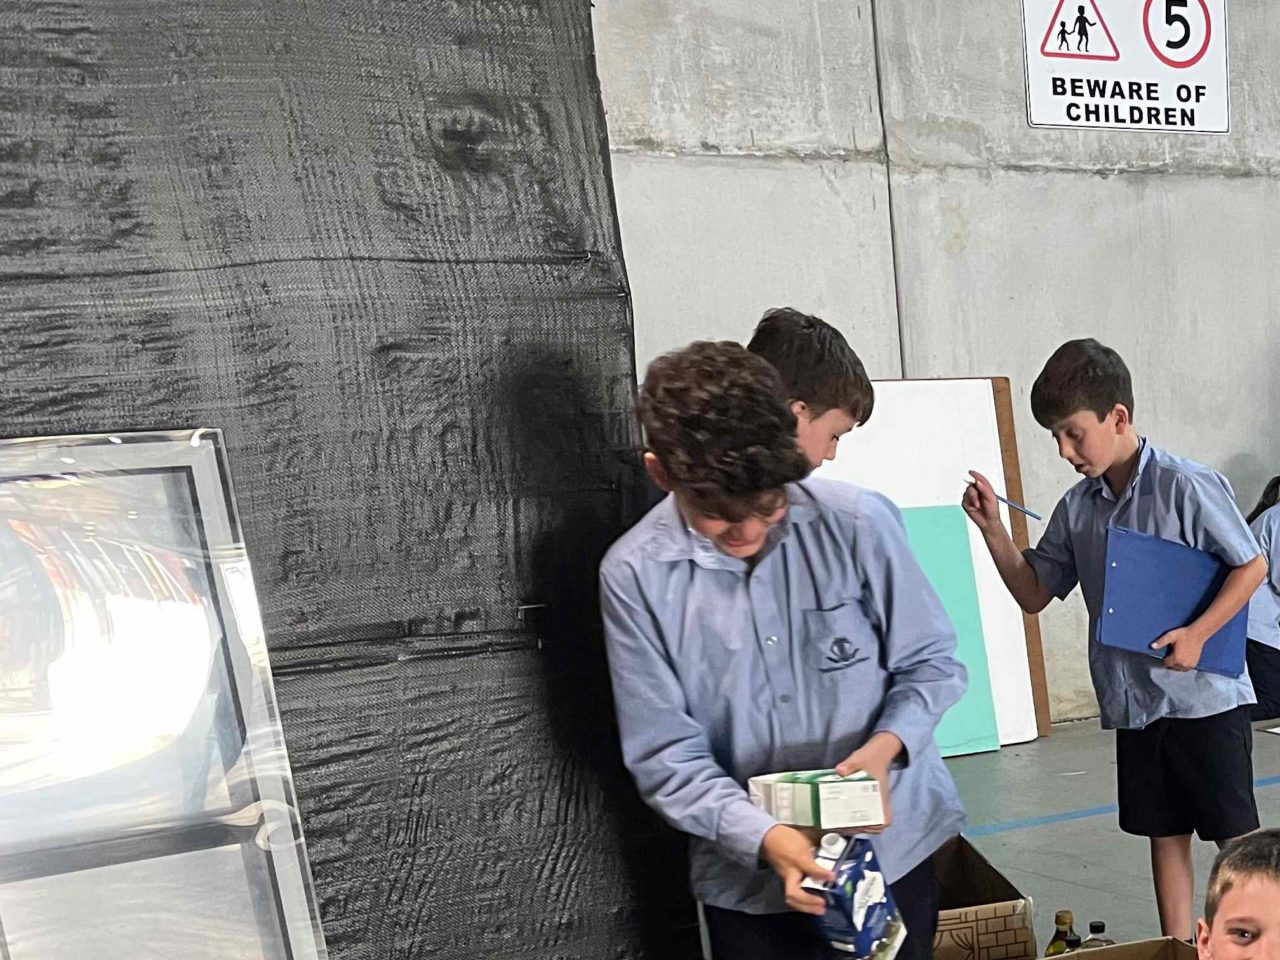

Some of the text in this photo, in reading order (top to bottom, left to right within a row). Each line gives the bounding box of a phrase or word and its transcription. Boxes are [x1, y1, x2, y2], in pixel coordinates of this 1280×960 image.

[1165, 0, 1191, 49] 5
[1052, 77, 1206, 103] BEWARE OF
[1066, 103, 1195, 126] CHILDREN
